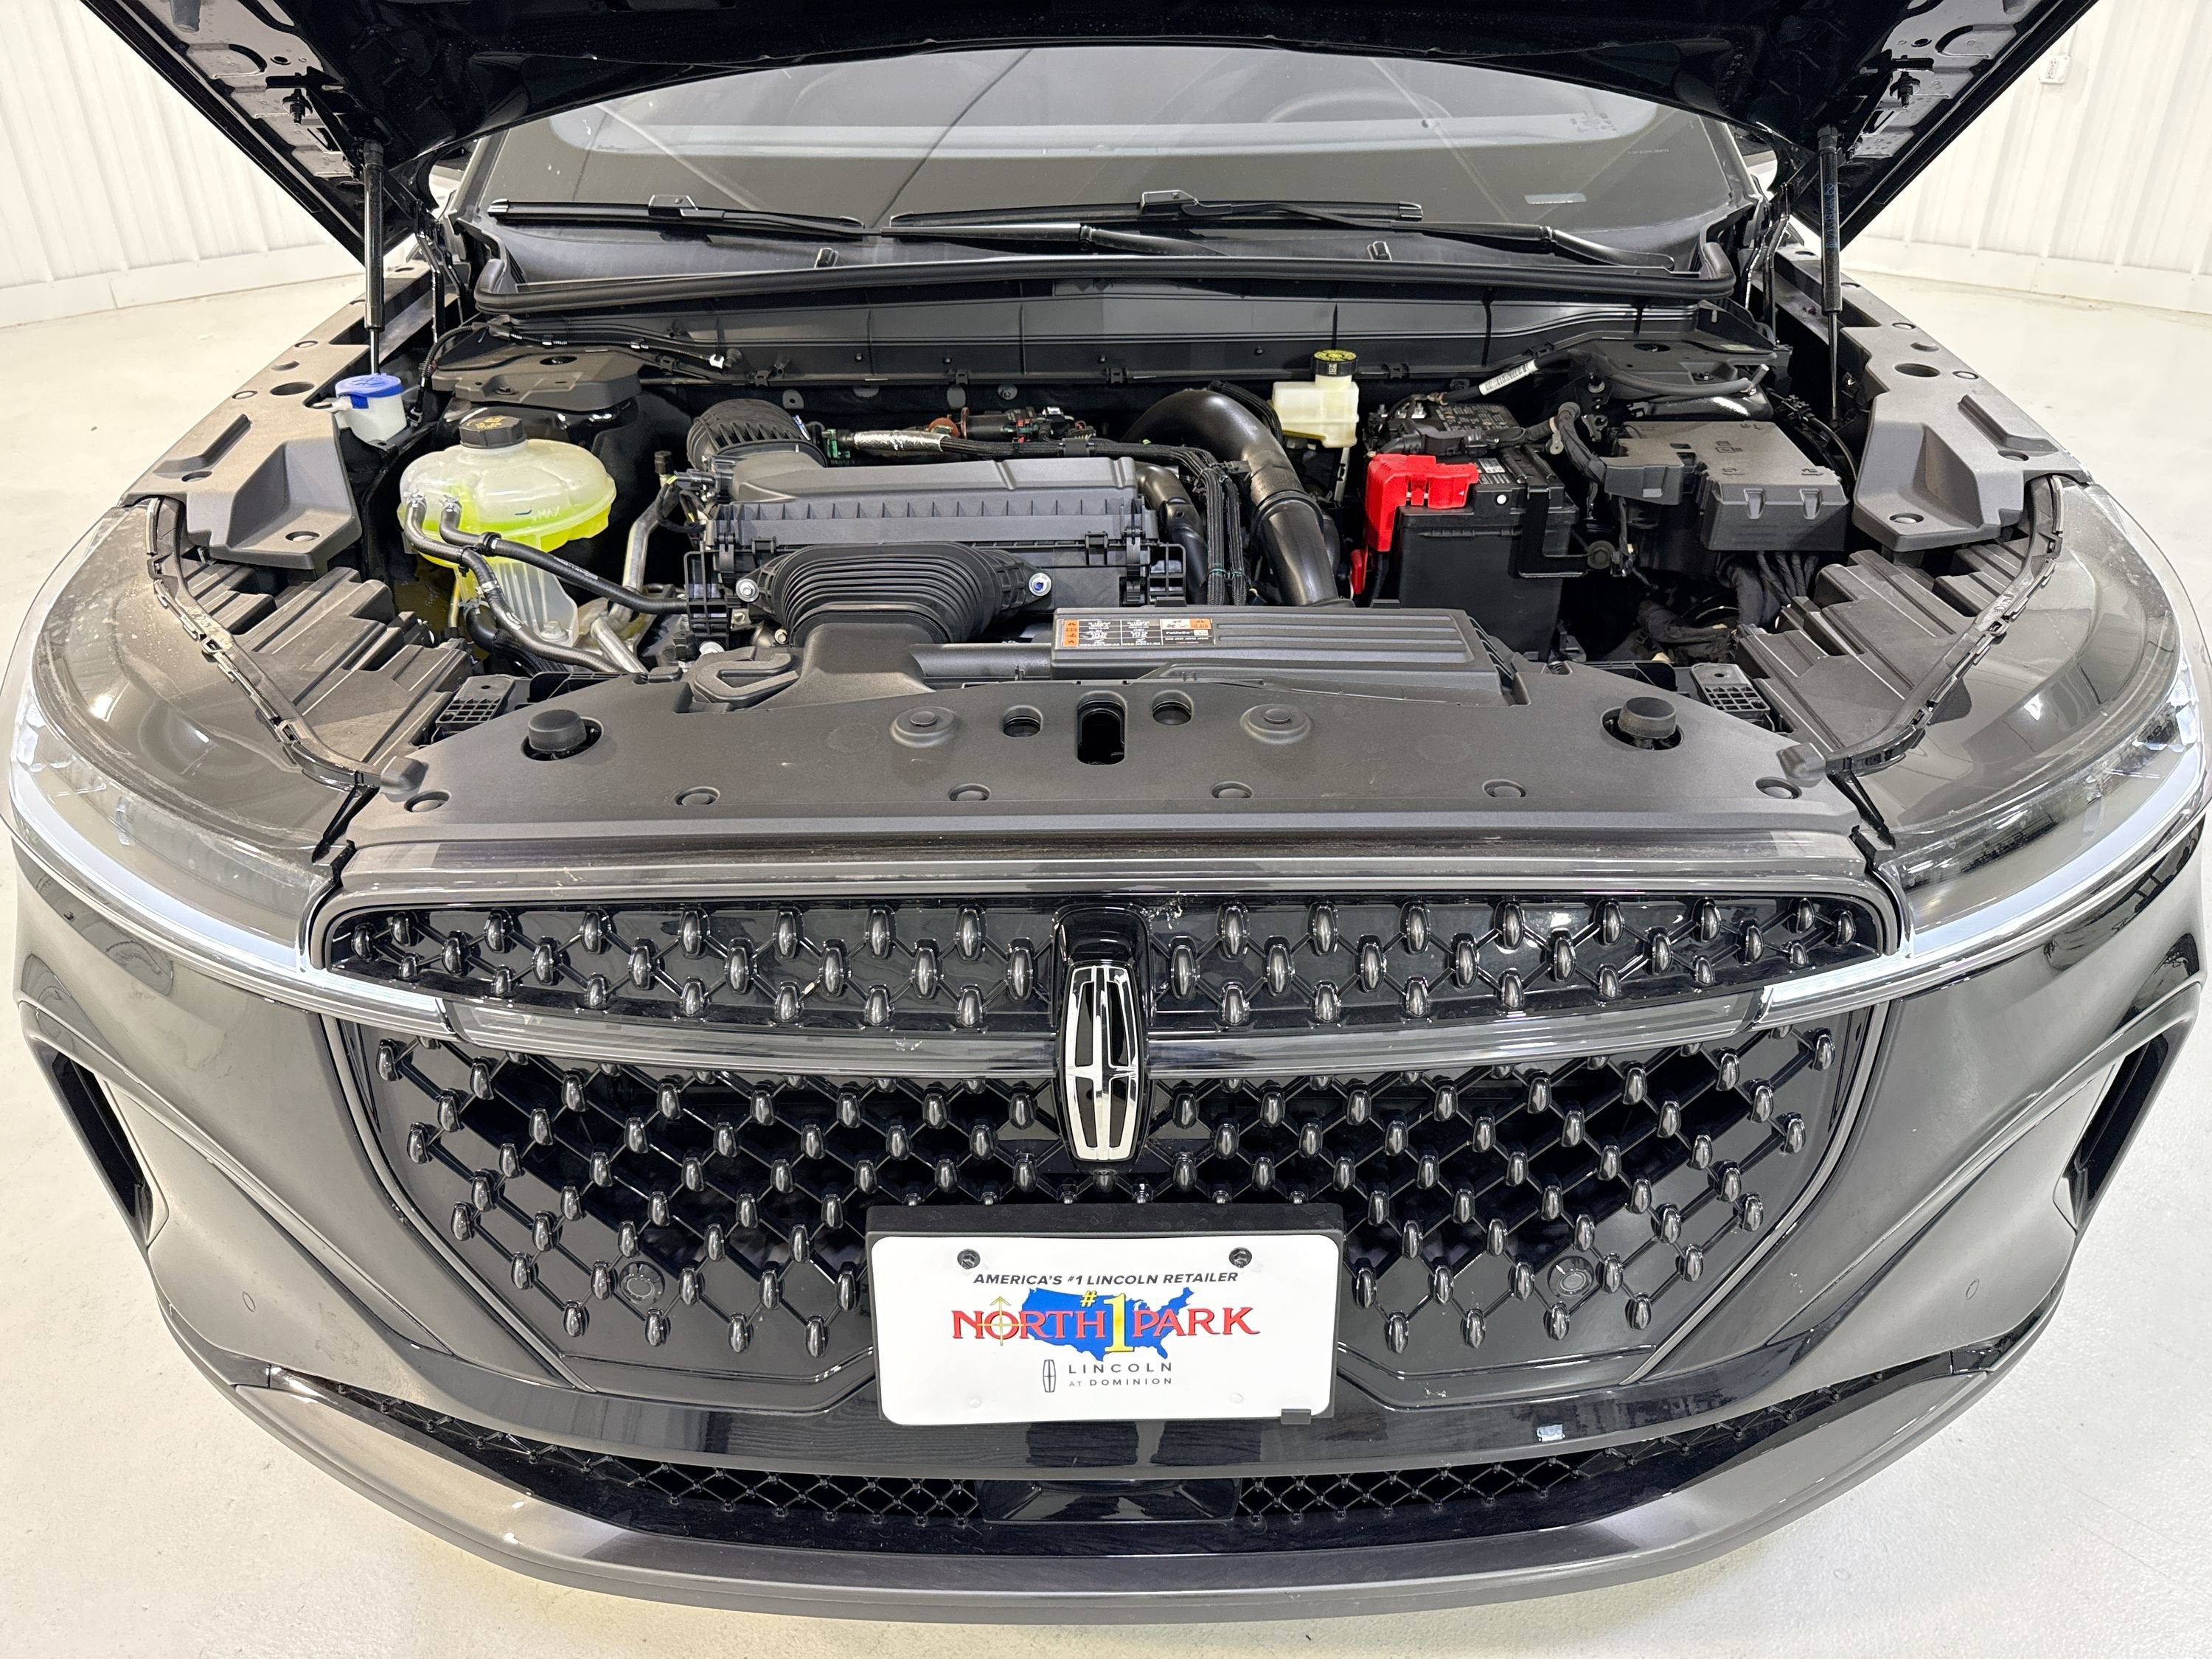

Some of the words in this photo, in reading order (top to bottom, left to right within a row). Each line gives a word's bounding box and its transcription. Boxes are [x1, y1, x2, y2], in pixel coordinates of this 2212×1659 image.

[973, 1273, 1062, 1285] AMERICA'S
[1067, 1275, 1082, 1285] #1
[1087, 1274, 1158, 1285] LINCOLN
[1163, 1272, 1239, 1284] RETAILER
[951, 1310, 1107, 1340] NORTH
[1132, 1307, 1261, 1338] PARK
[1068, 1362, 1172, 1374] LINCOLN
[1089, 1377, 1172, 1386] DOMINION
